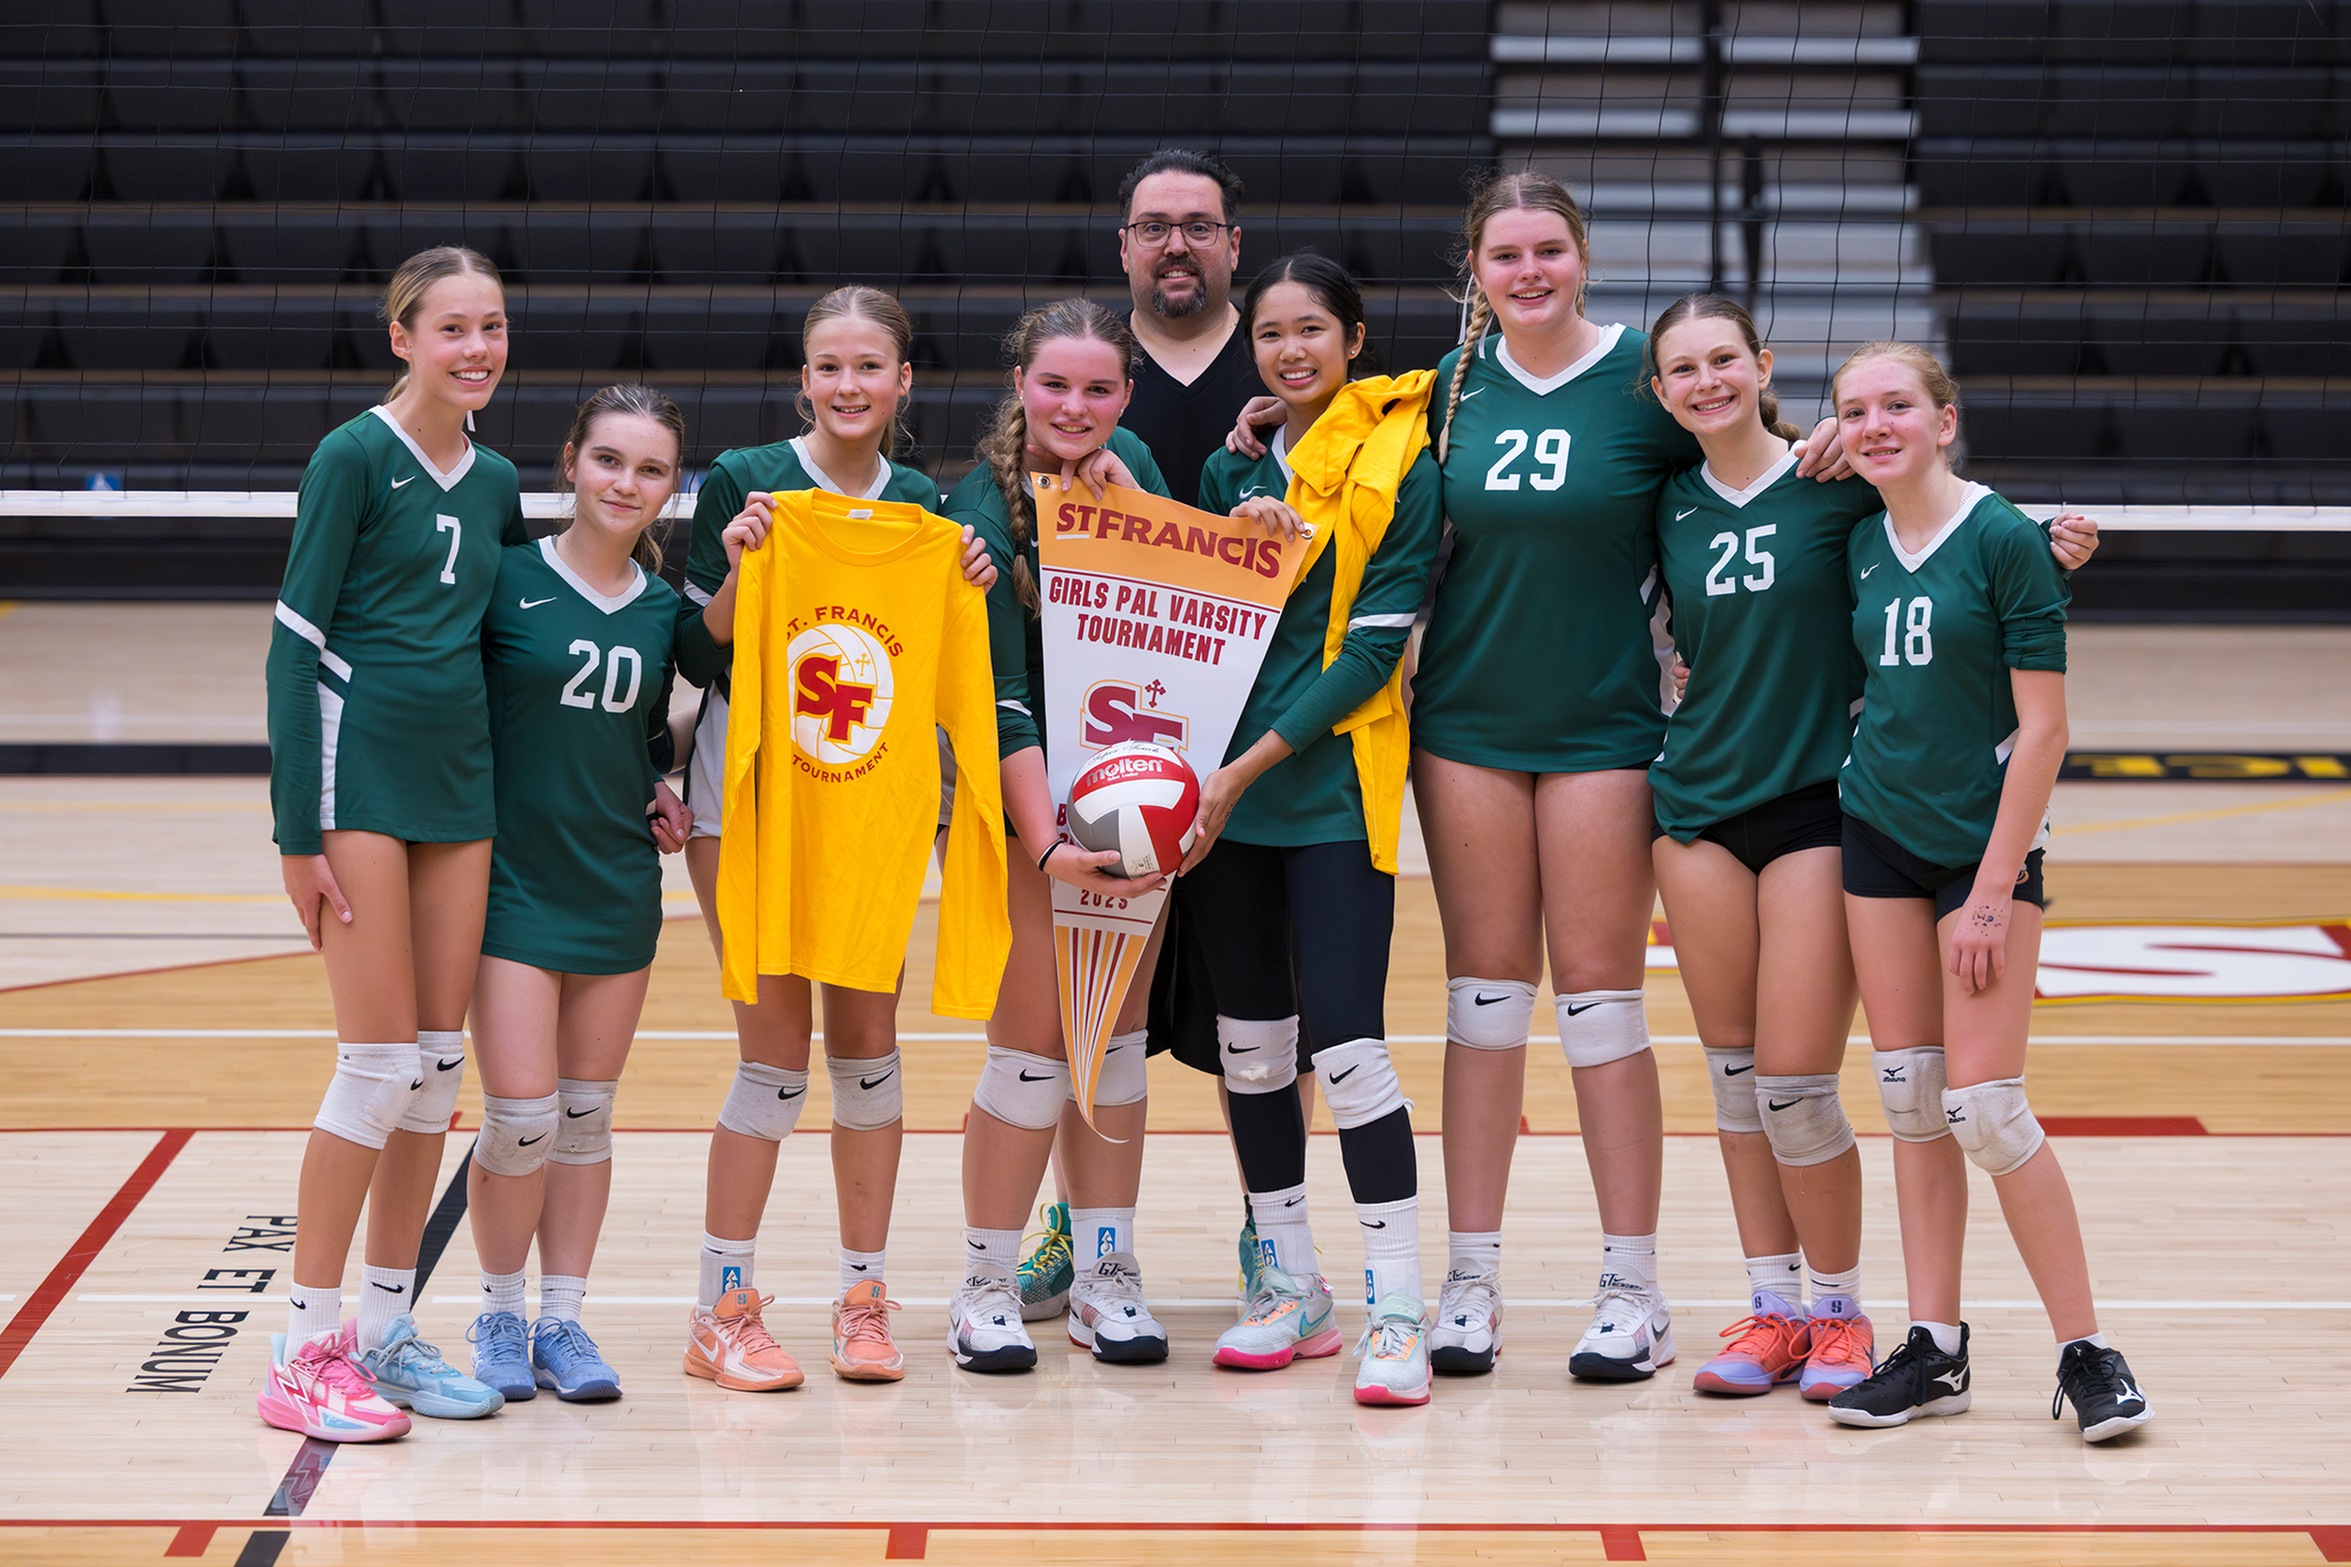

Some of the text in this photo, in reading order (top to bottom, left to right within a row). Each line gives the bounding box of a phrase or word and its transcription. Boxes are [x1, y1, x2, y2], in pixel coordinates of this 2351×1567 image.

[1484, 429, 1572, 492] 29
[436, 514, 461, 585] 7
[1706, 523, 1777, 596] 25
[815, 606, 904, 658] FRANCIS
[1049, 576, 1267, 640] GIRLS PAL VARSITY
[1879, 596, 1934, 666] 18
[1077, 614, 1226, 666] TOURNAMENT
[560, 639, 643, 714] 20
[796, 656, 874, 741] SF
[793, 741, 889, 783] TOURNAMENT
[1087, 758, 1162, 787] molten
[222, 1214, 298, 1253] PAX
[196, 1268, 278, 1293] ET
[125, 1310, 250, 1394] BONUM
